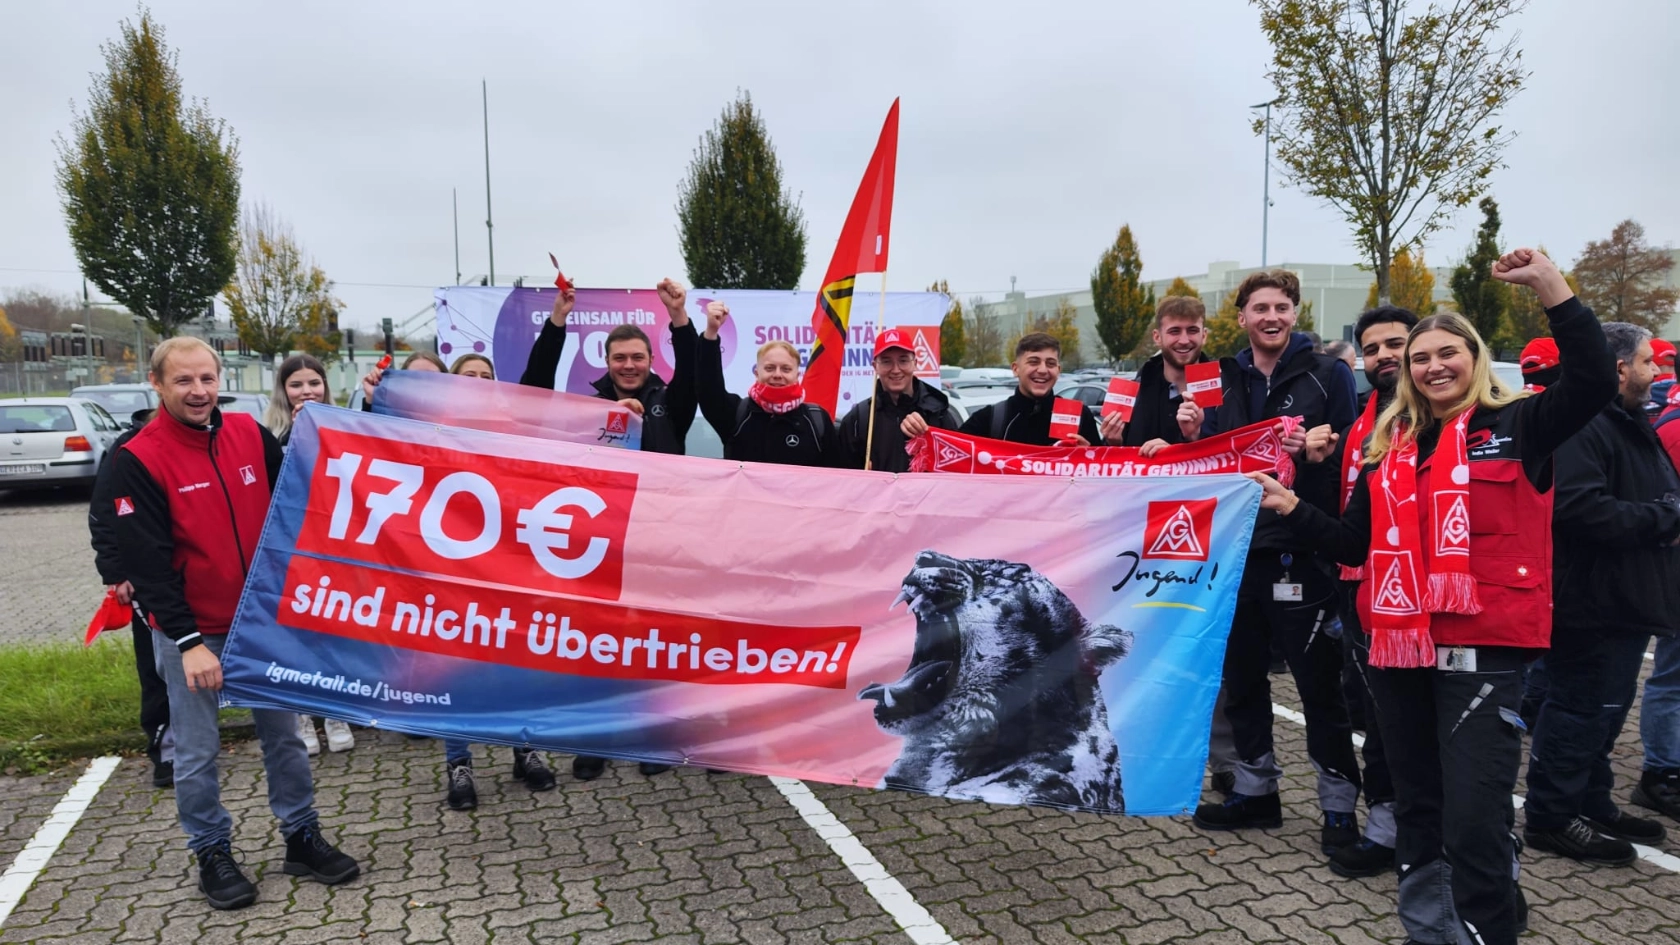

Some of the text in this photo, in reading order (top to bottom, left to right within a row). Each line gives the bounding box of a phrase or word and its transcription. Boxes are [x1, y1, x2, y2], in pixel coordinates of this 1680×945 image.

[532, 309, 656, 325] GEEINSAM FÜR
[755, 321, 886, 345] SOLIDITÄ
[1021, 452, 1236, 477] SOLIDARITÄT GEWINNT!
[325, 451, 502, 560] 170
[1112, 550, 1218, 597] Jugend!
[291, 575, 847, 674] sind nicht übertrieben!
[265, 661, 451, 705] igmetall.de/jugend
